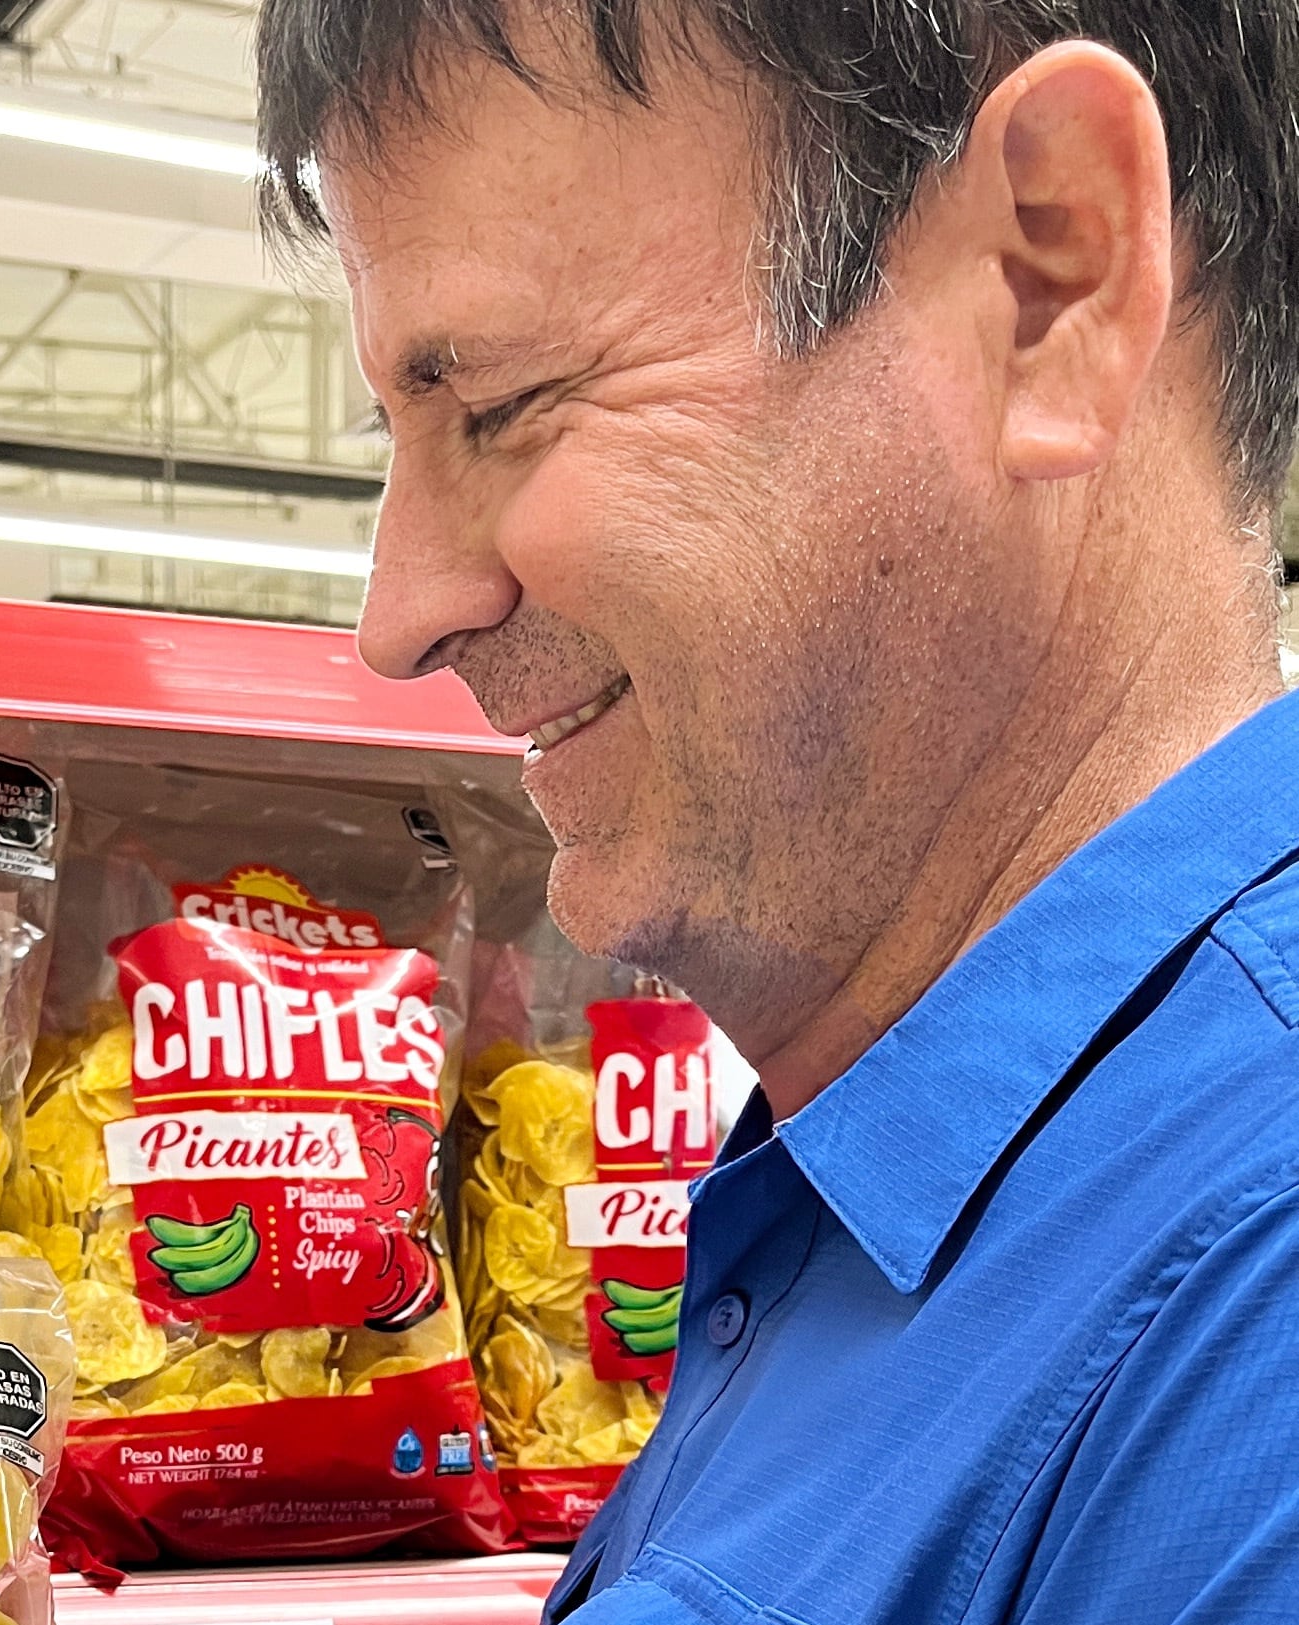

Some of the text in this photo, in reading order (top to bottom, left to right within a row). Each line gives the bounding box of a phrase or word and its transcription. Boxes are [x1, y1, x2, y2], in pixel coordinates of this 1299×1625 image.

[182, 894, 380, 954] Crickets
[133, 978, 445, 1090] CHIFLES
[140, 1119, 351, 1173] Picantes
[284, 1185, 364, 1209] Plantain
[300, 1212, 355, 1240] Chips
[293, 1242, 363, 1284] Spicy
[10, 1372, 30, 1385] EN
[120, 1442, 264, 1465] Peso Neto 500 g
[129, 1469, 156, 1484] NET
[160, 1467, 210, 1482] WEIGHT
